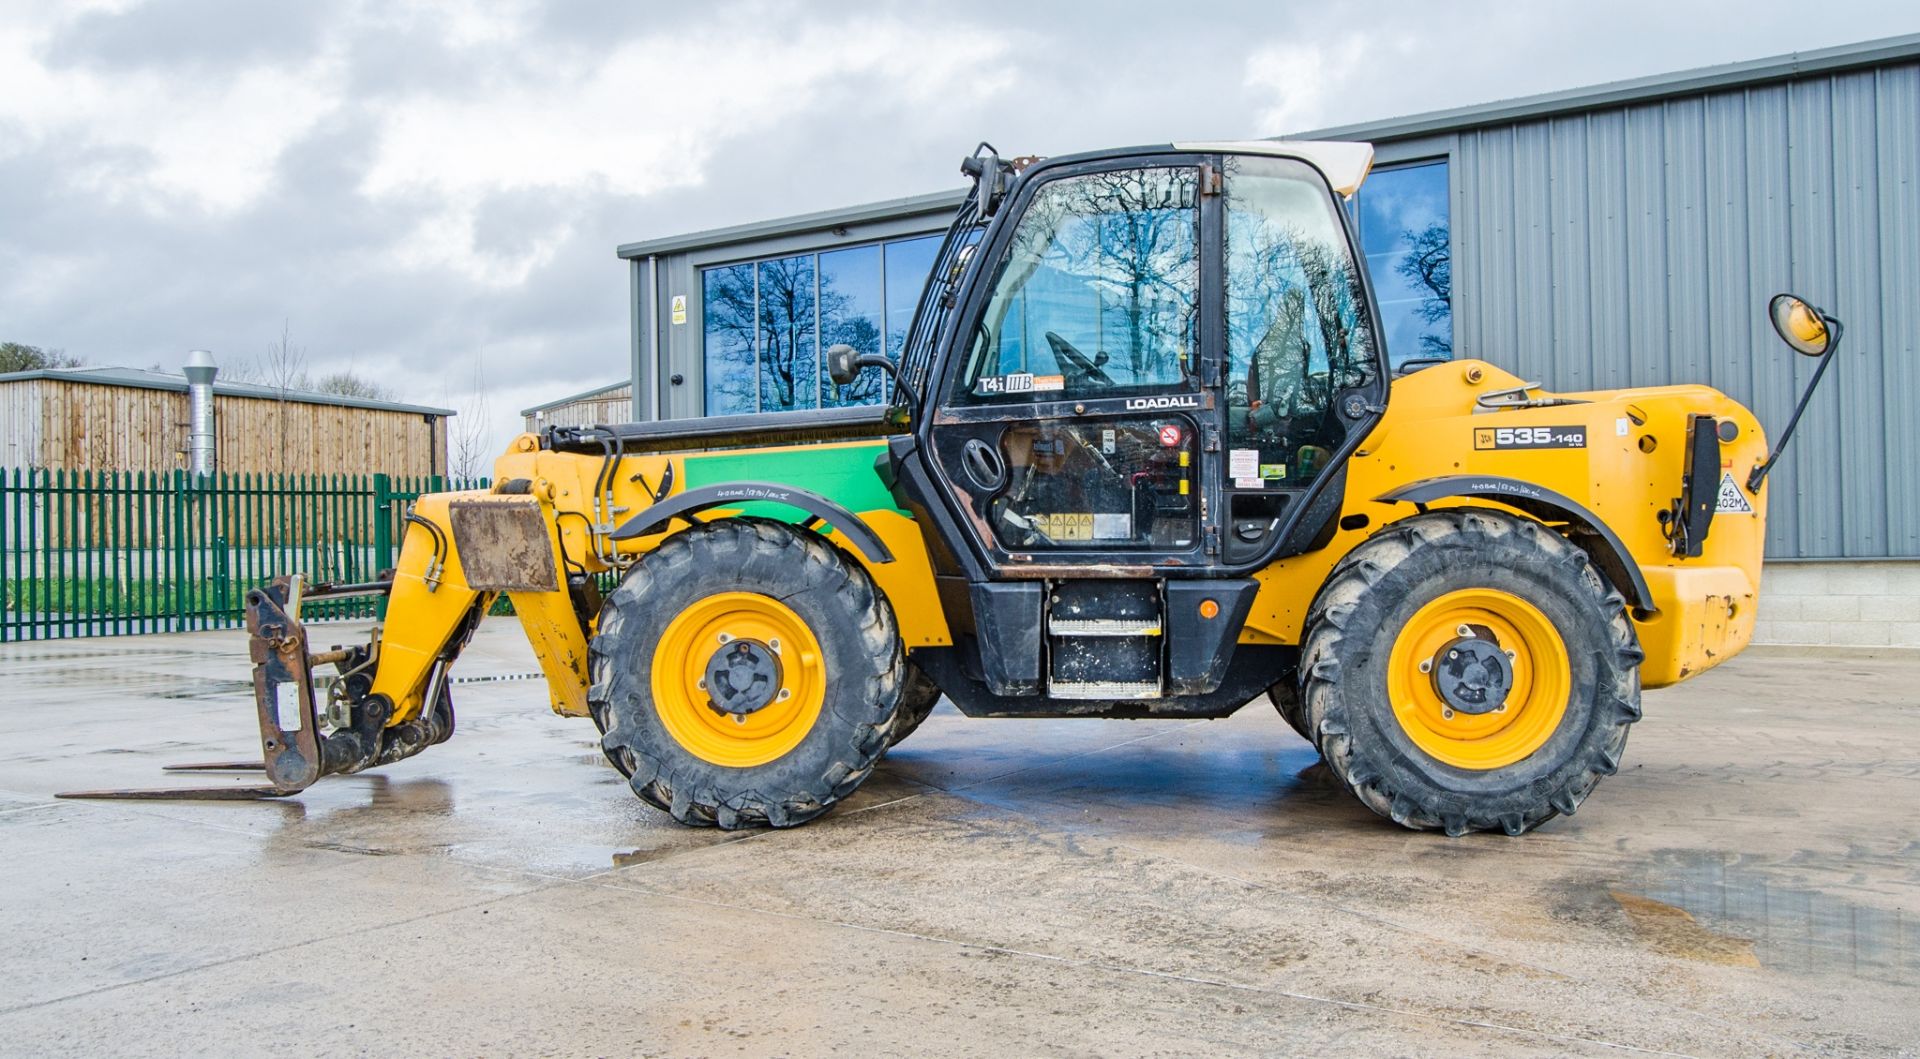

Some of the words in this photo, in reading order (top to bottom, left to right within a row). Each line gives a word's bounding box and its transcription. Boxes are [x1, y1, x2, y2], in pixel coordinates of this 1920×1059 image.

[979, 377, 1006, 392] T4i
[1126, 396, 1198, 410] LOADALL
[1496, 427, 1583, 444] 535-140
[1722, 488, 1735, 498] 46
